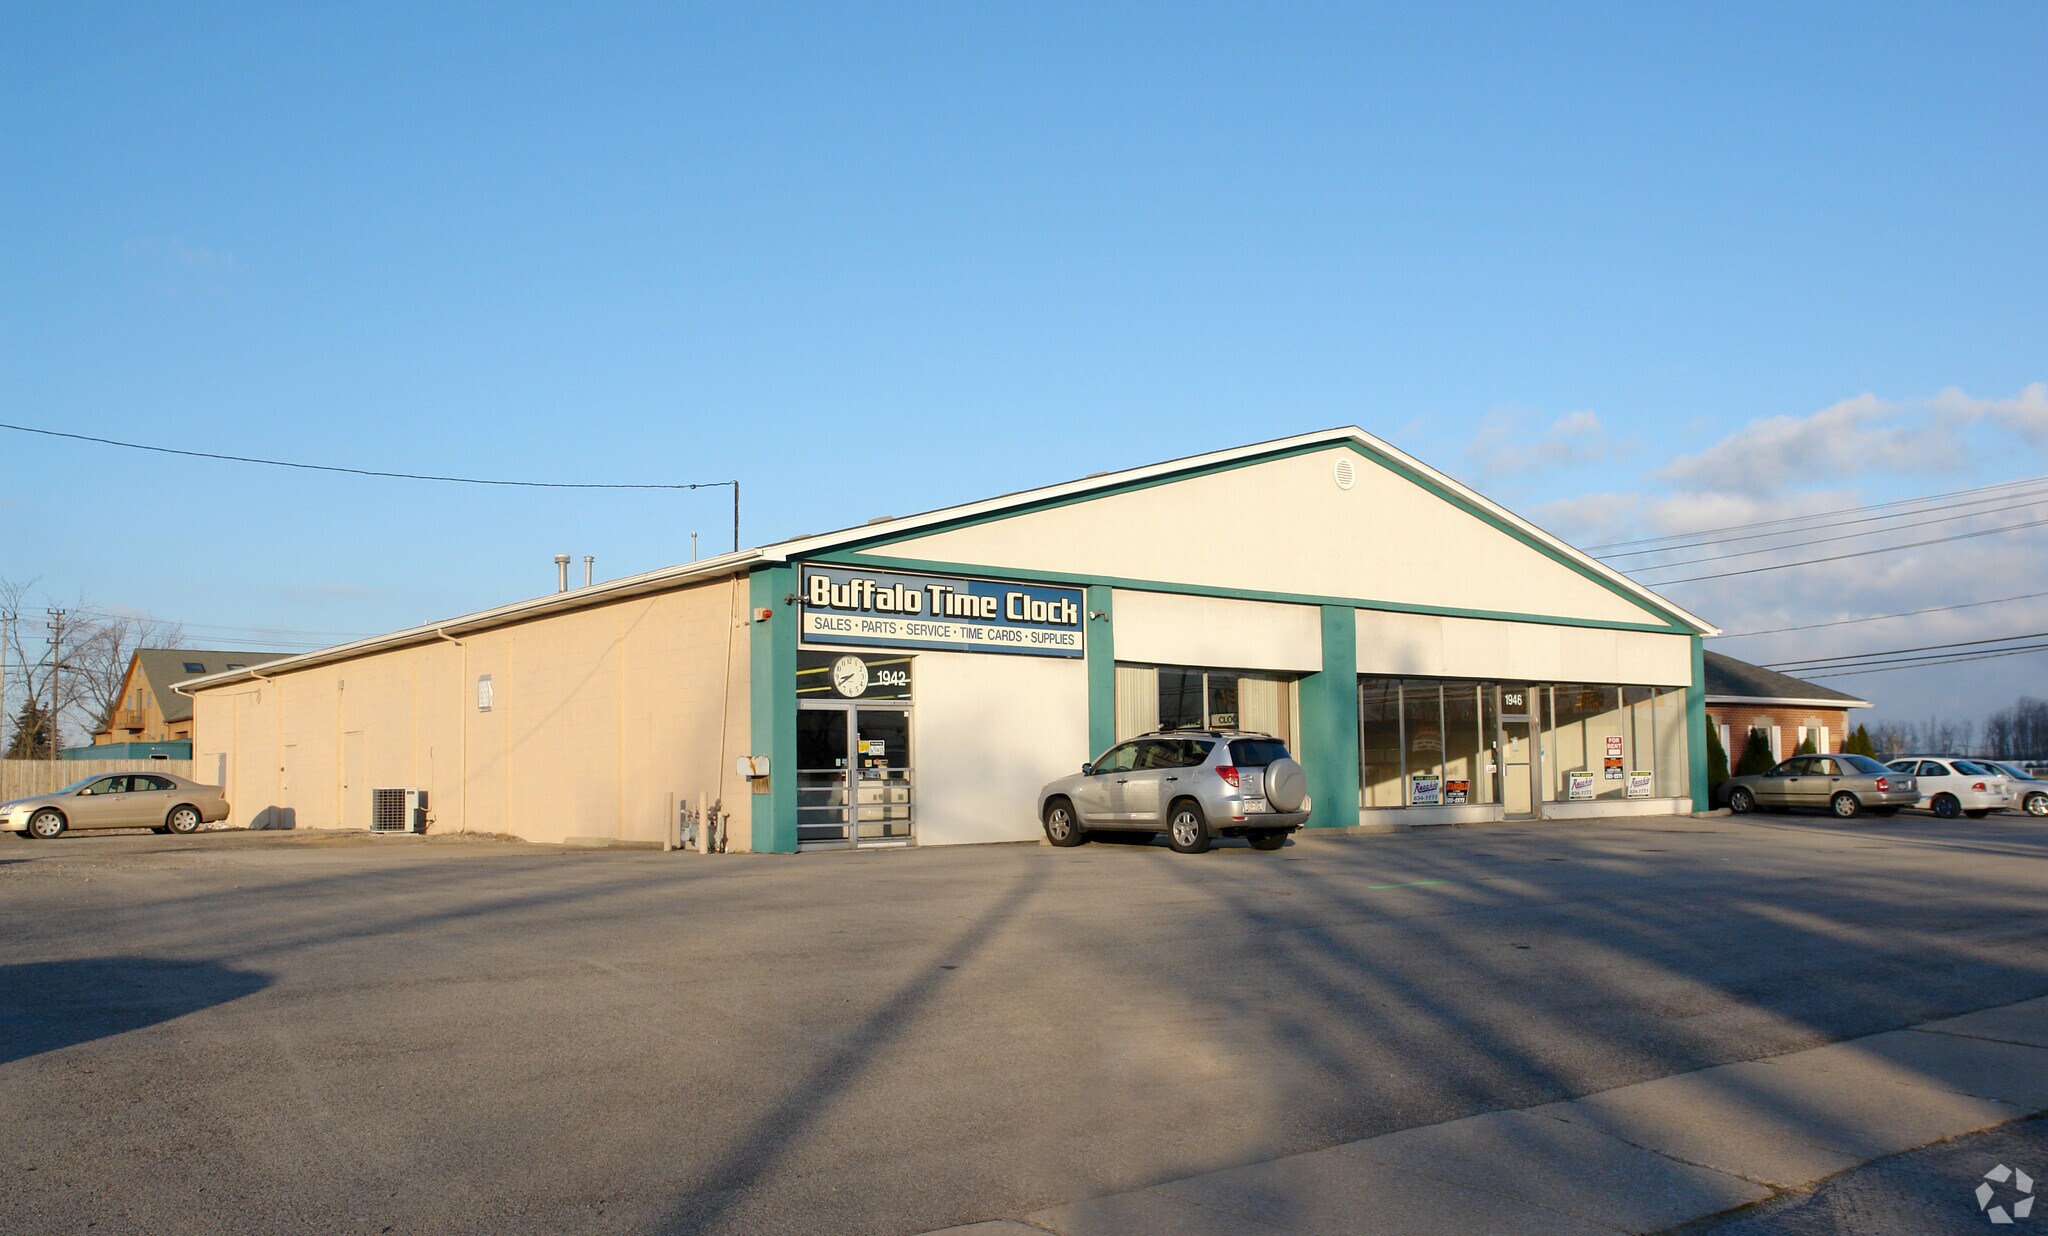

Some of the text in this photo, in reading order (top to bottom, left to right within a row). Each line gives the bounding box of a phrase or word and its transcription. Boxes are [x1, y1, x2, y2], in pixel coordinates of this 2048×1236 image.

[809, 575, 1077, 626] Buffalo Time Clock
[815, 617, 1075, 645] SALES PARTS SERVICE TIME CARDS SUPPLIES
[877, 670, 906, 686] 1942
[1504, 694, 1522, 706] 1946
